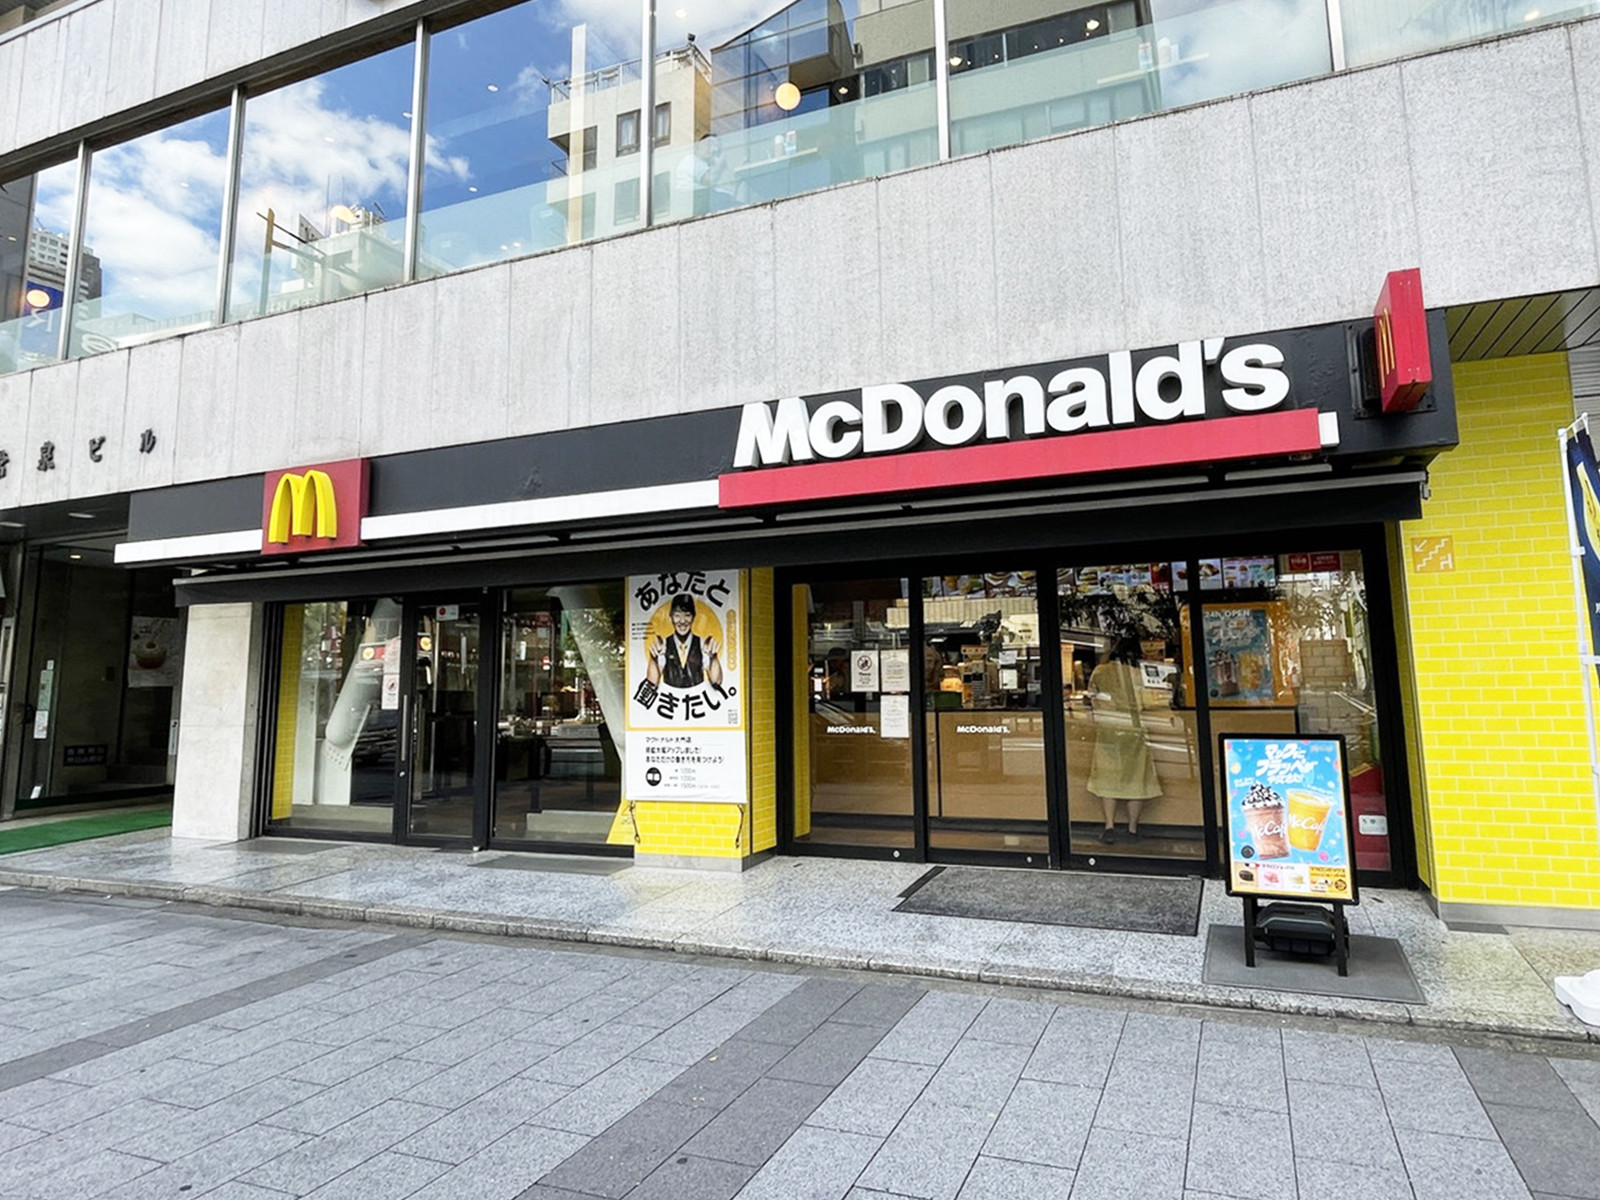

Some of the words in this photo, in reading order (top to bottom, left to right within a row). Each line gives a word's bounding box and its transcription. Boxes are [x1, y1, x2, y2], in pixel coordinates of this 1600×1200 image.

[732, 337, 1290, 468] McDonald's
[634, 570, 731, 612] あなたと
